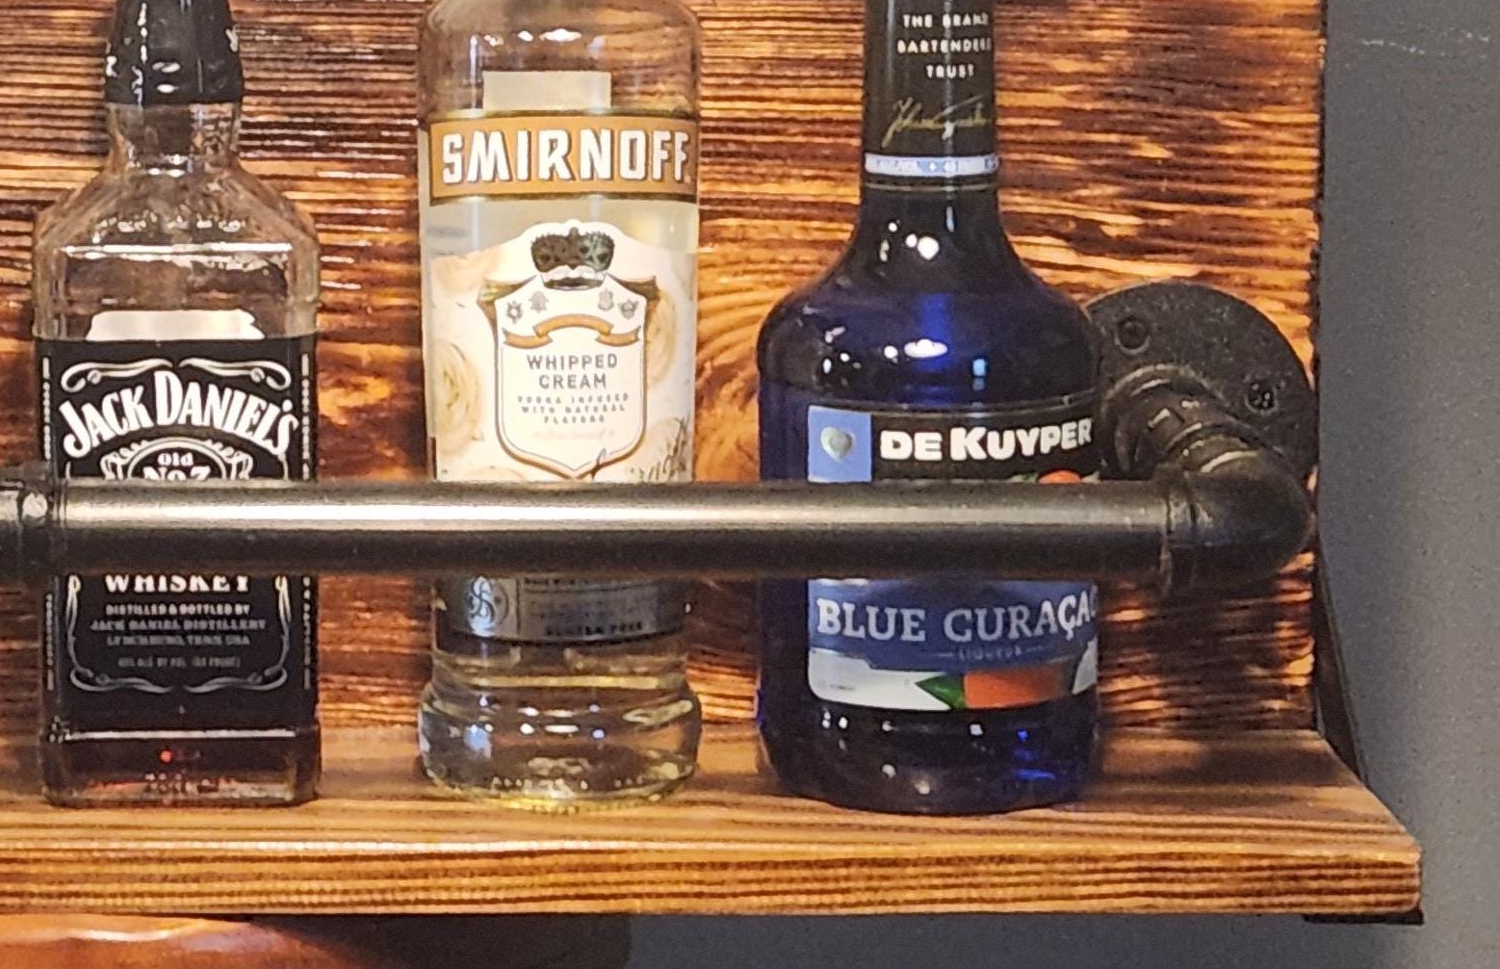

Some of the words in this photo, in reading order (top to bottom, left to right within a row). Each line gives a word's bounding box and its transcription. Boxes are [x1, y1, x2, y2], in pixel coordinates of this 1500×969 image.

[903, 14, 933, 28] THE
[926, 64, 974, 79] TRUST
[442, 128, 690, 184] SMIRNOFF
[526, 353, 618, 370] WHIPPED
[539, 373, 607, 389] CREAM
[58, 385, 154, 458] JACK
[880, 430, 943, 461] DE
[950, 417, 1093, 461] KUYPER
[157, 452, 194, 466] Old
[105, 574, 249, 593] WHISKEY
[816, 597, 927, 643] BLUE
